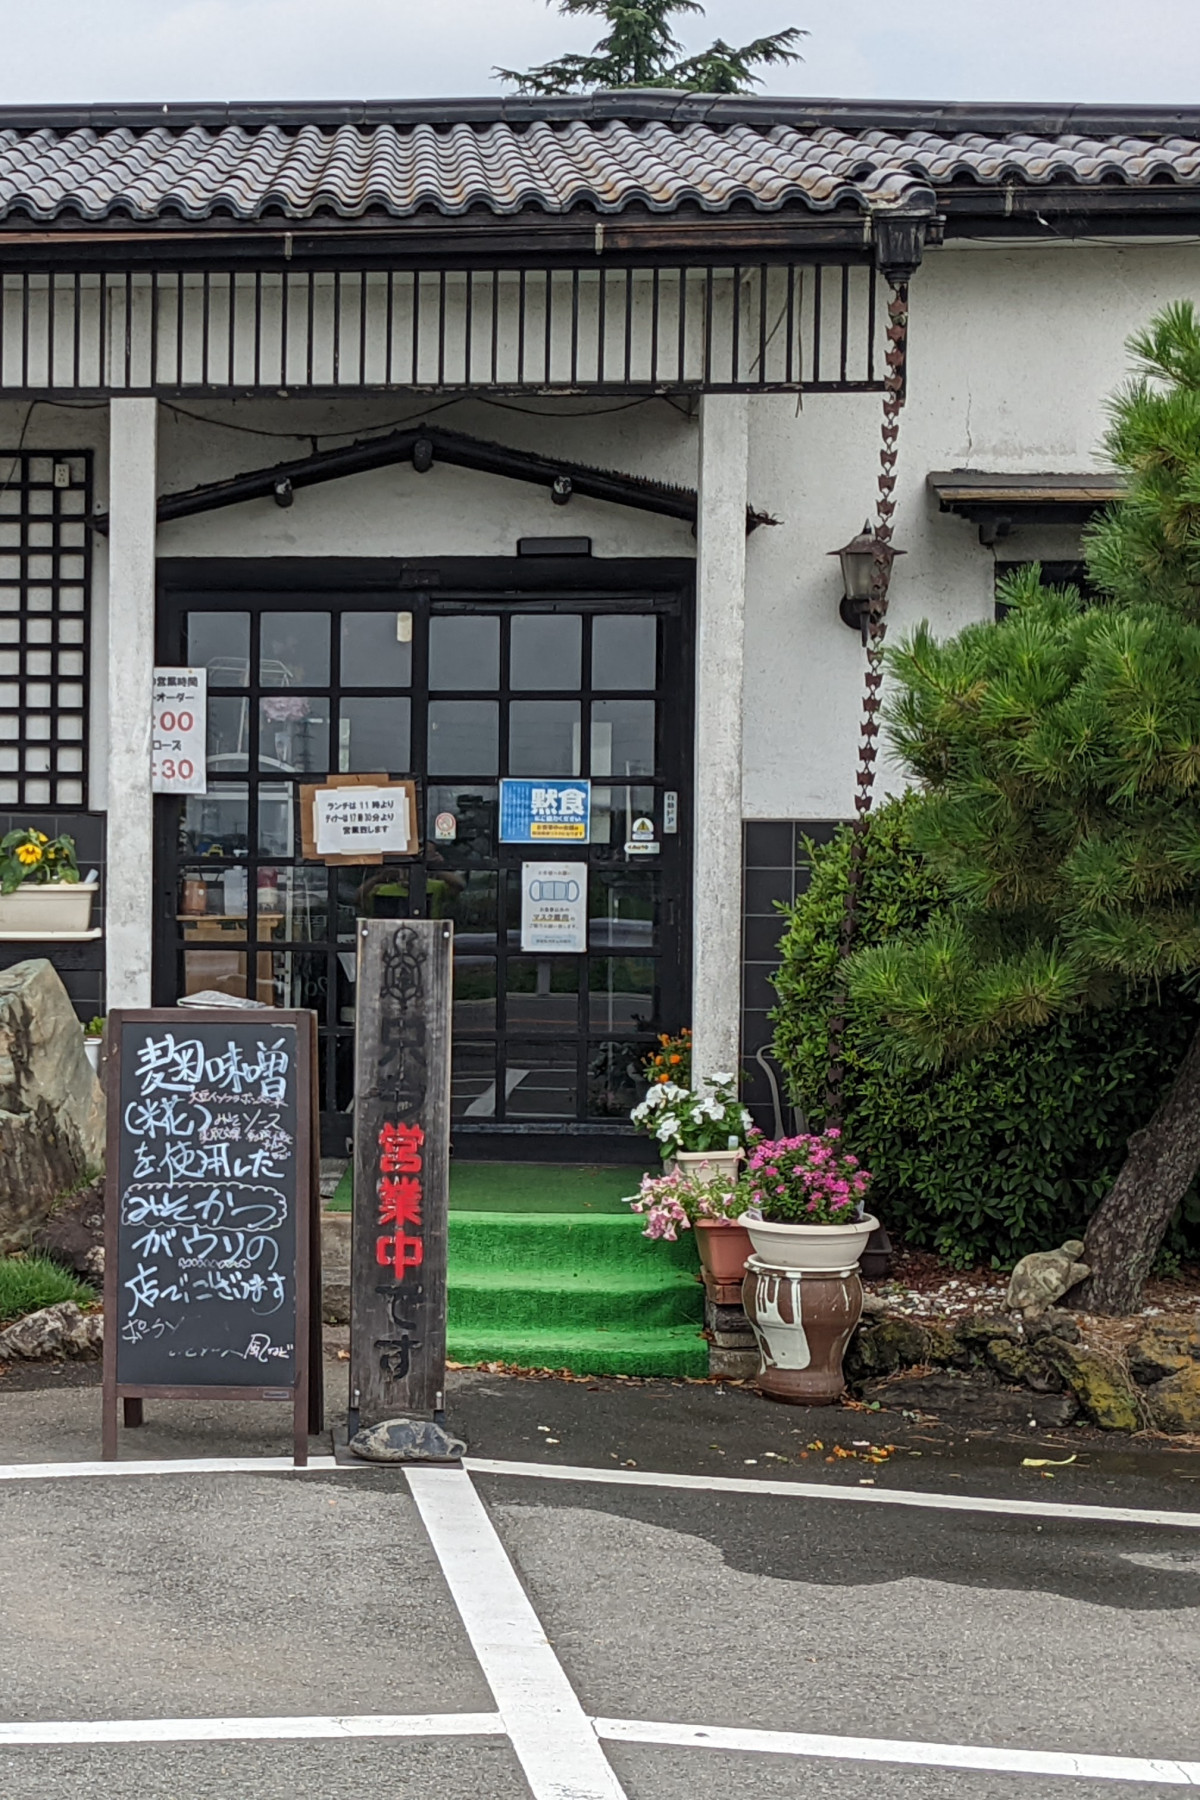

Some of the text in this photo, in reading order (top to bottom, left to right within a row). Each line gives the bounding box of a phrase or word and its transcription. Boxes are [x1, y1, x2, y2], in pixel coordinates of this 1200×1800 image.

[153, 676, 198, 687] 営業時間
[153, 692, 195, 703] オーダー
[531, 788, 587, 816] 黙食
[127, 1188, 278, 1229] みそかつ
